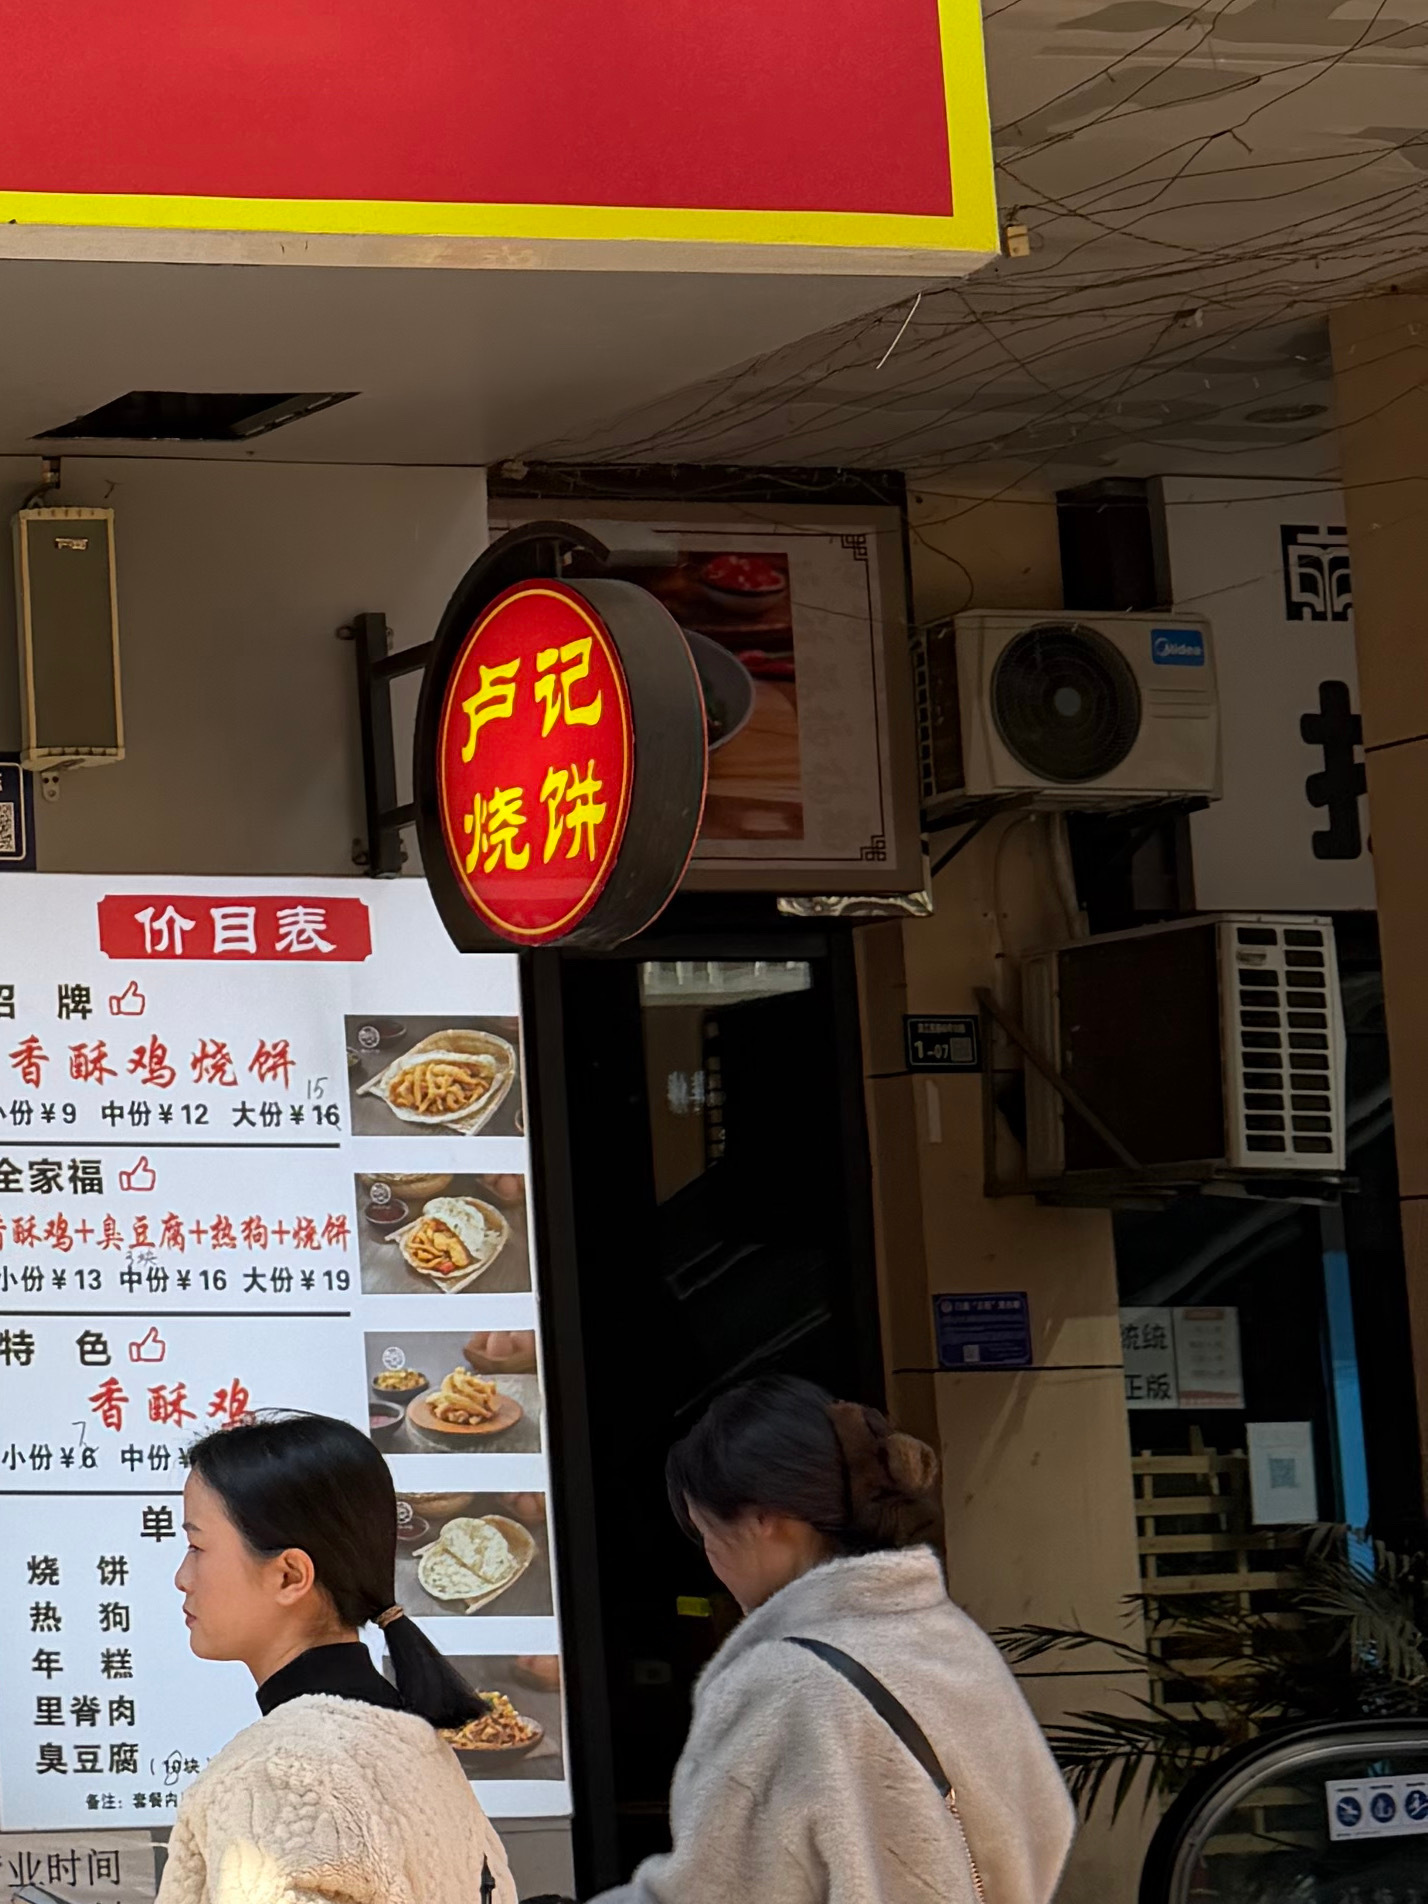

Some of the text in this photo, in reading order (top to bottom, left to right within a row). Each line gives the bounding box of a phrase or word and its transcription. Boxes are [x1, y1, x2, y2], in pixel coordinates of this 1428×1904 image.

[461, 636, 602, 764] 卢记
[462, 758, 607, 874] 烧饼
[134, 904, 337, 955] 价目表
[8, 1033, 297, 1091] 香酥鸡烧饼
[140, 1505, 177, 1543] 单
[27, 1555, 130, 1587] 烧饼
[30, 1601, 131, 1633] 热狗
[32, 1648, 134, 1680] 年糕
[34, 1695, 136, 1727] 里脊肉
[36, 1742, 139, 1775] 臭豆腐
